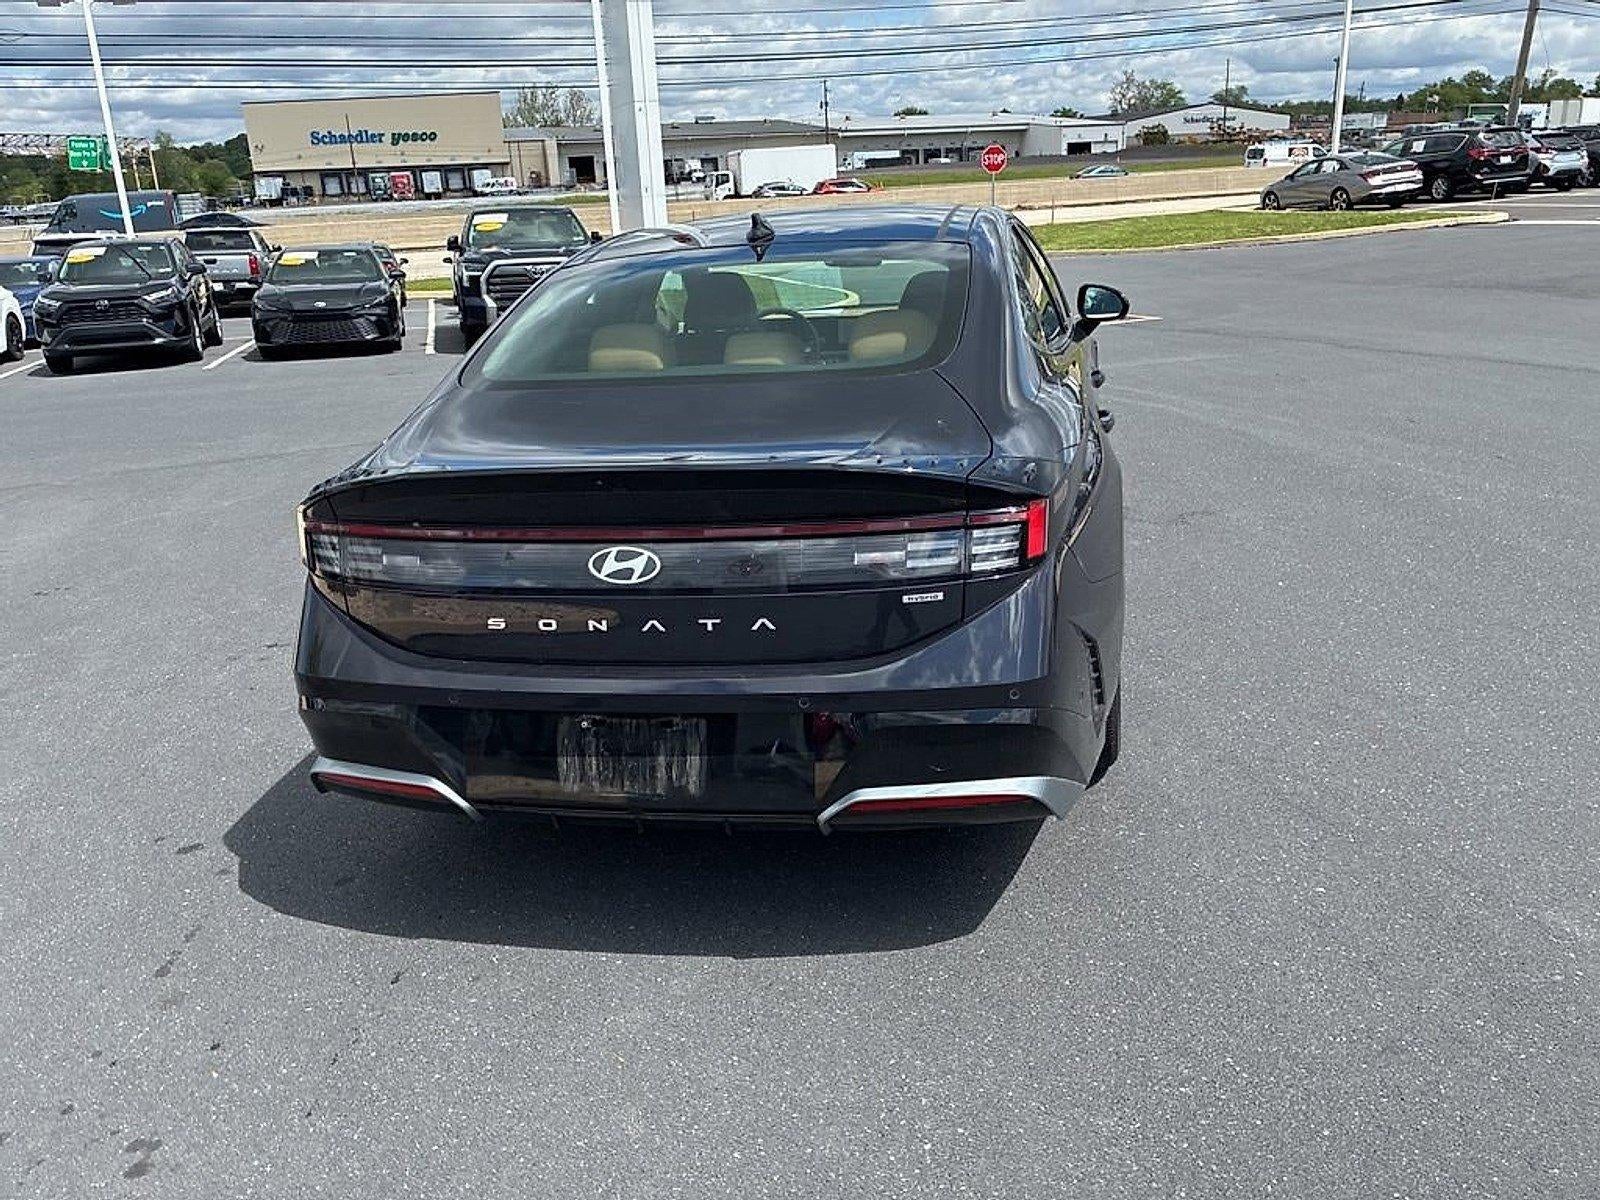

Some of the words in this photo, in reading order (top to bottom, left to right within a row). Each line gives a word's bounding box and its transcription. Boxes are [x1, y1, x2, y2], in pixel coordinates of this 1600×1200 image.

[310, 129, 385, 145] Schaedler
[983, 153, 1005, 165] STOP
[487, 617, 777, 632] SONATA
